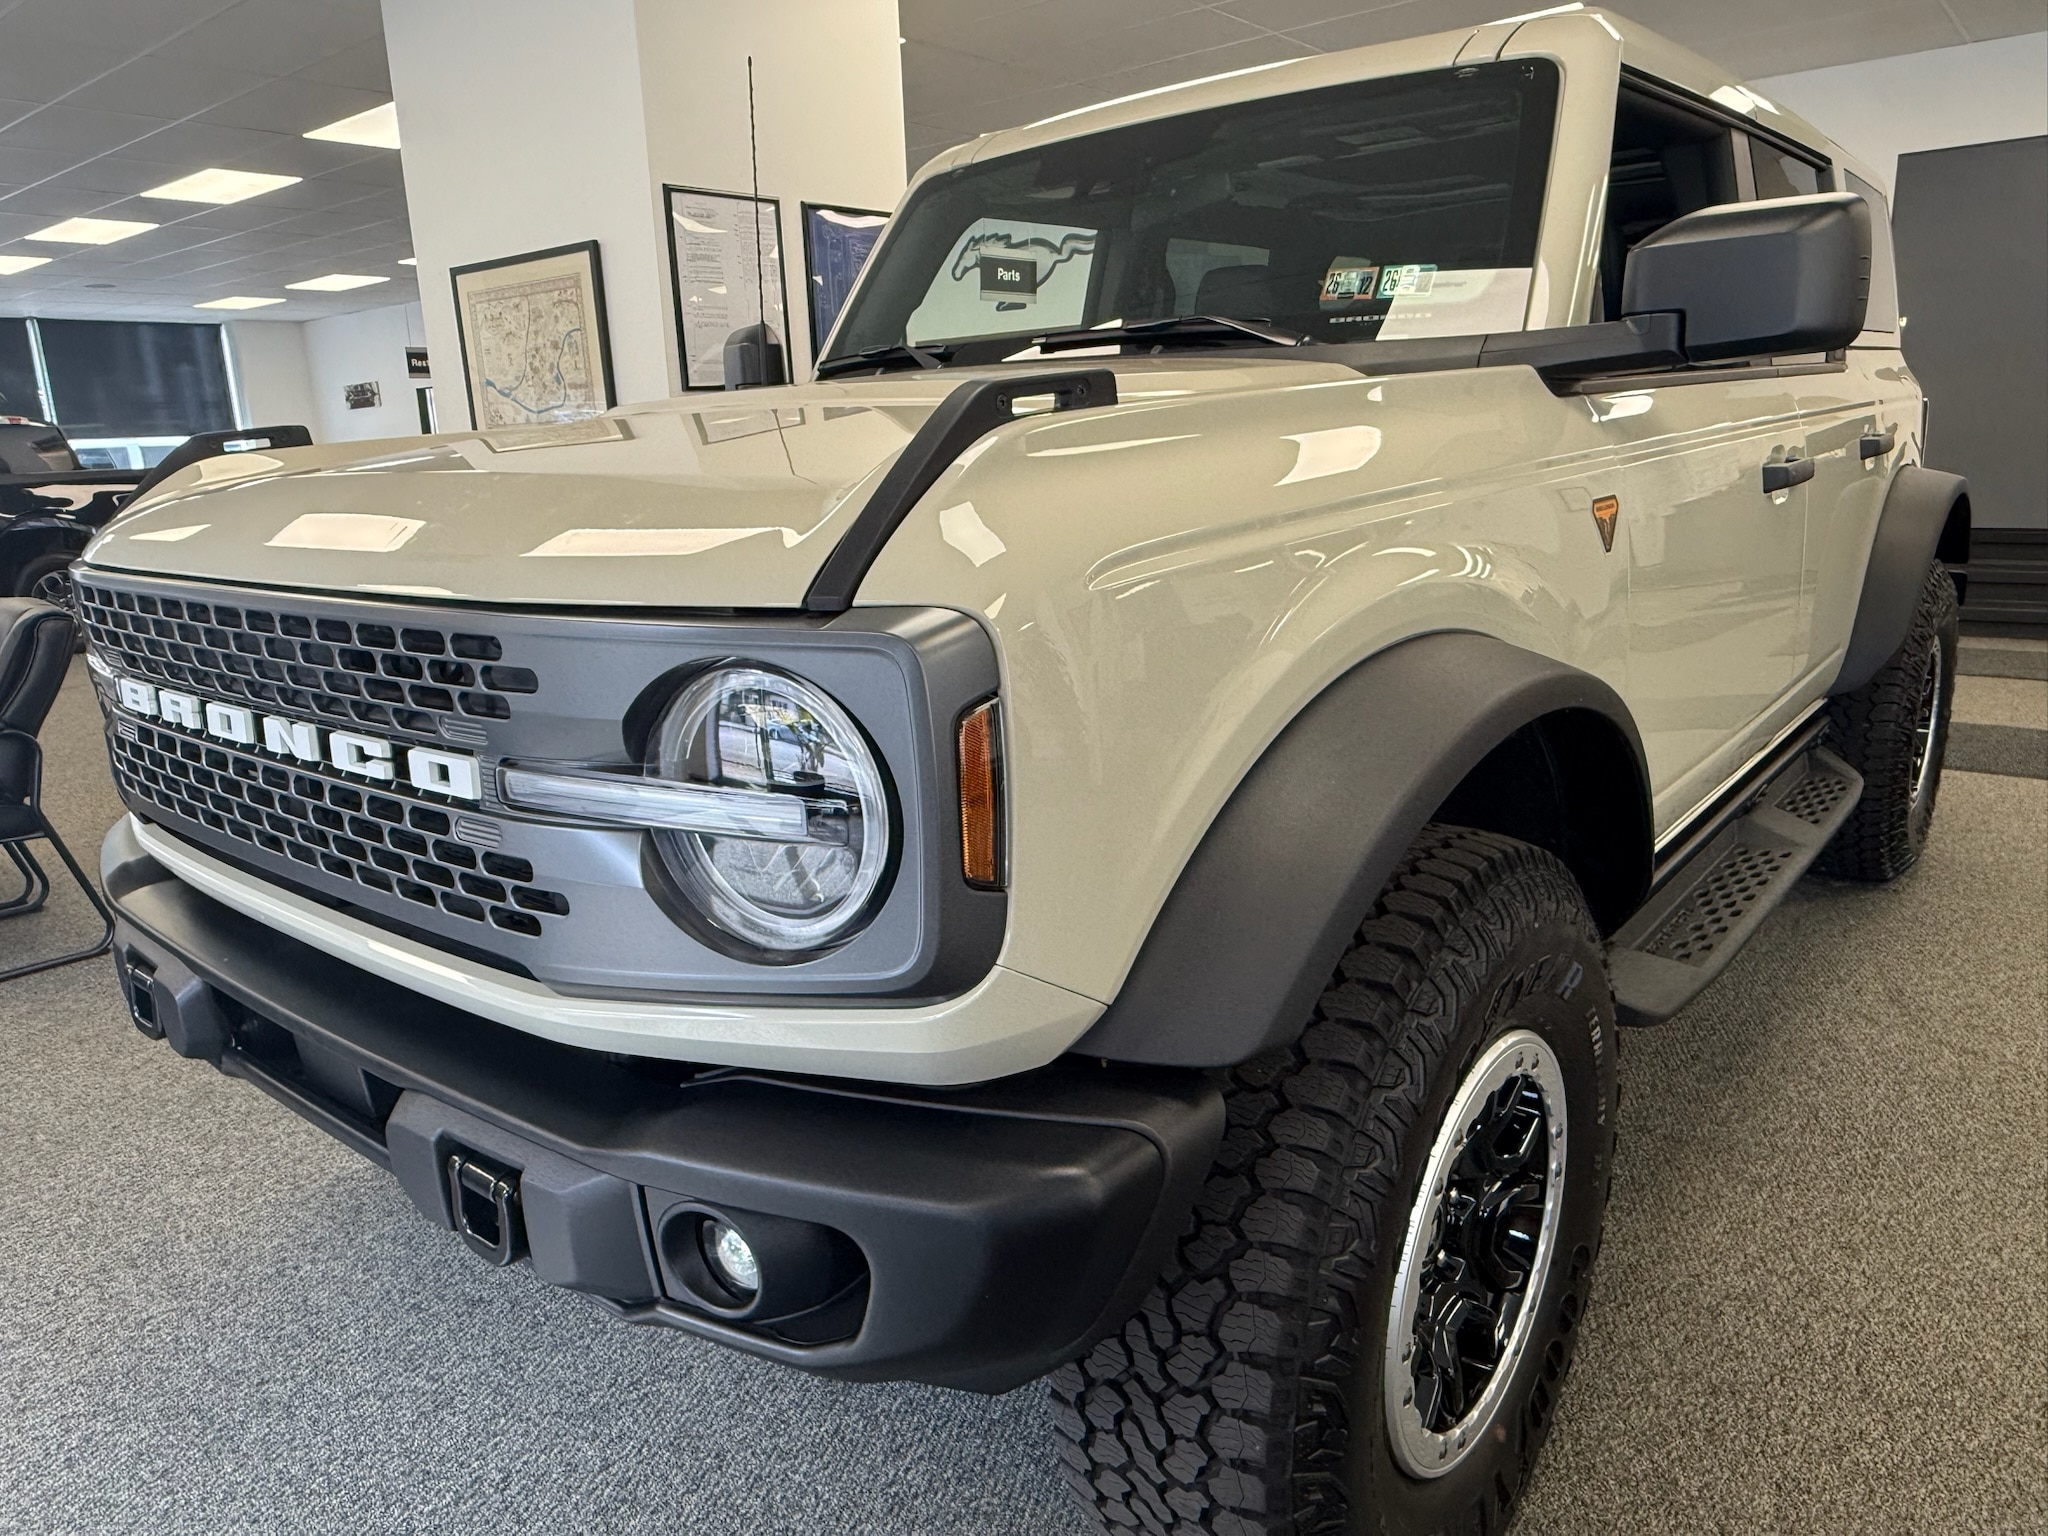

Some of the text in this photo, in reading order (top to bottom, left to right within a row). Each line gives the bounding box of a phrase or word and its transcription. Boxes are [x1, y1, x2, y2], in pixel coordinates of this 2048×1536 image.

[997, 267, 1020, 282] Parts
[1326, 272, 1373, 295] 26 12
[120, 678, 482, 800] BRONCO
[1585, 1004, 1606, 1126] TERRIORY
